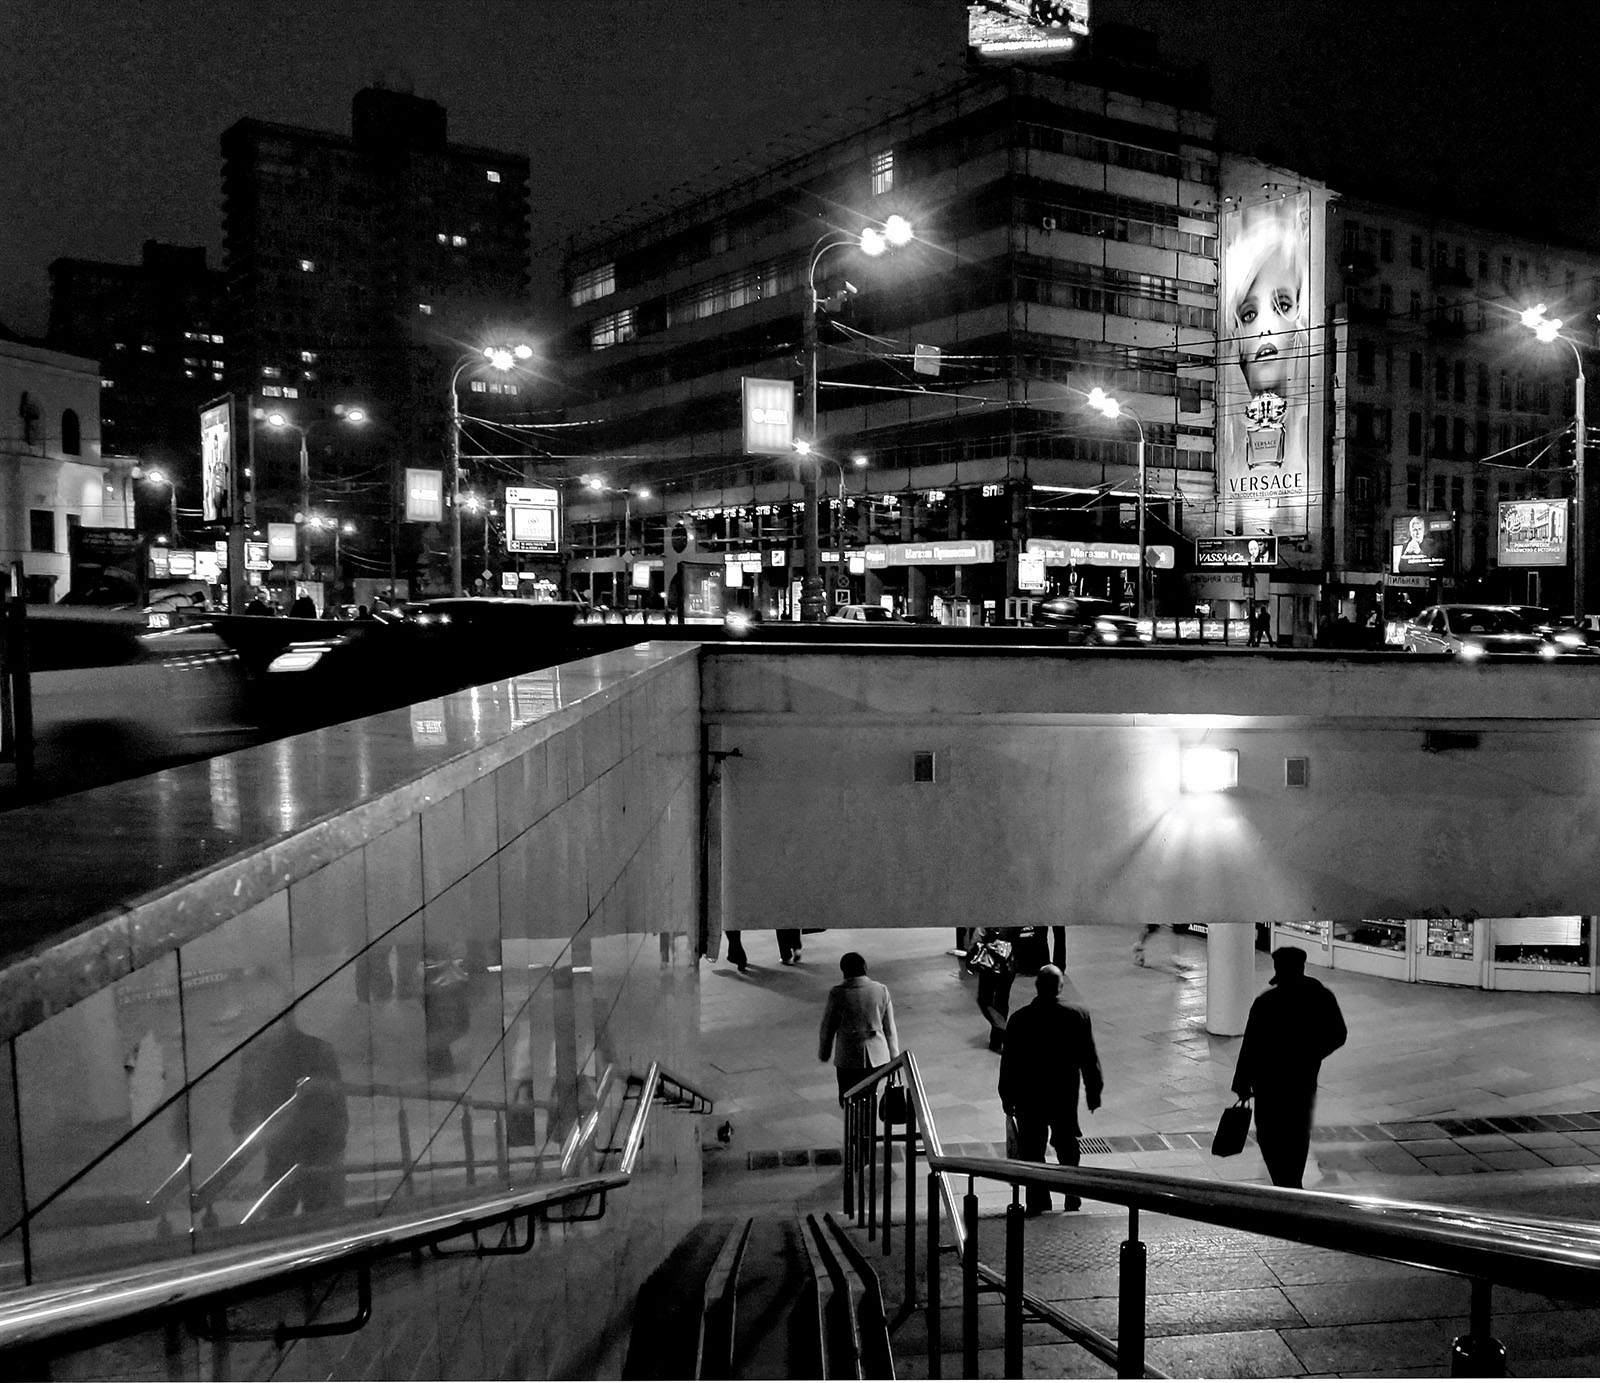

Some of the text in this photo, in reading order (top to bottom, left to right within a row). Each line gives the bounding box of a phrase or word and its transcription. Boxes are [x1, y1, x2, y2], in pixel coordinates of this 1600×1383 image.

[1254, 440, 1277, 448] VERSACE
[1229, 472, 1302, 492] VERSACE
[1070, 547, 1109, 559] Магазин
